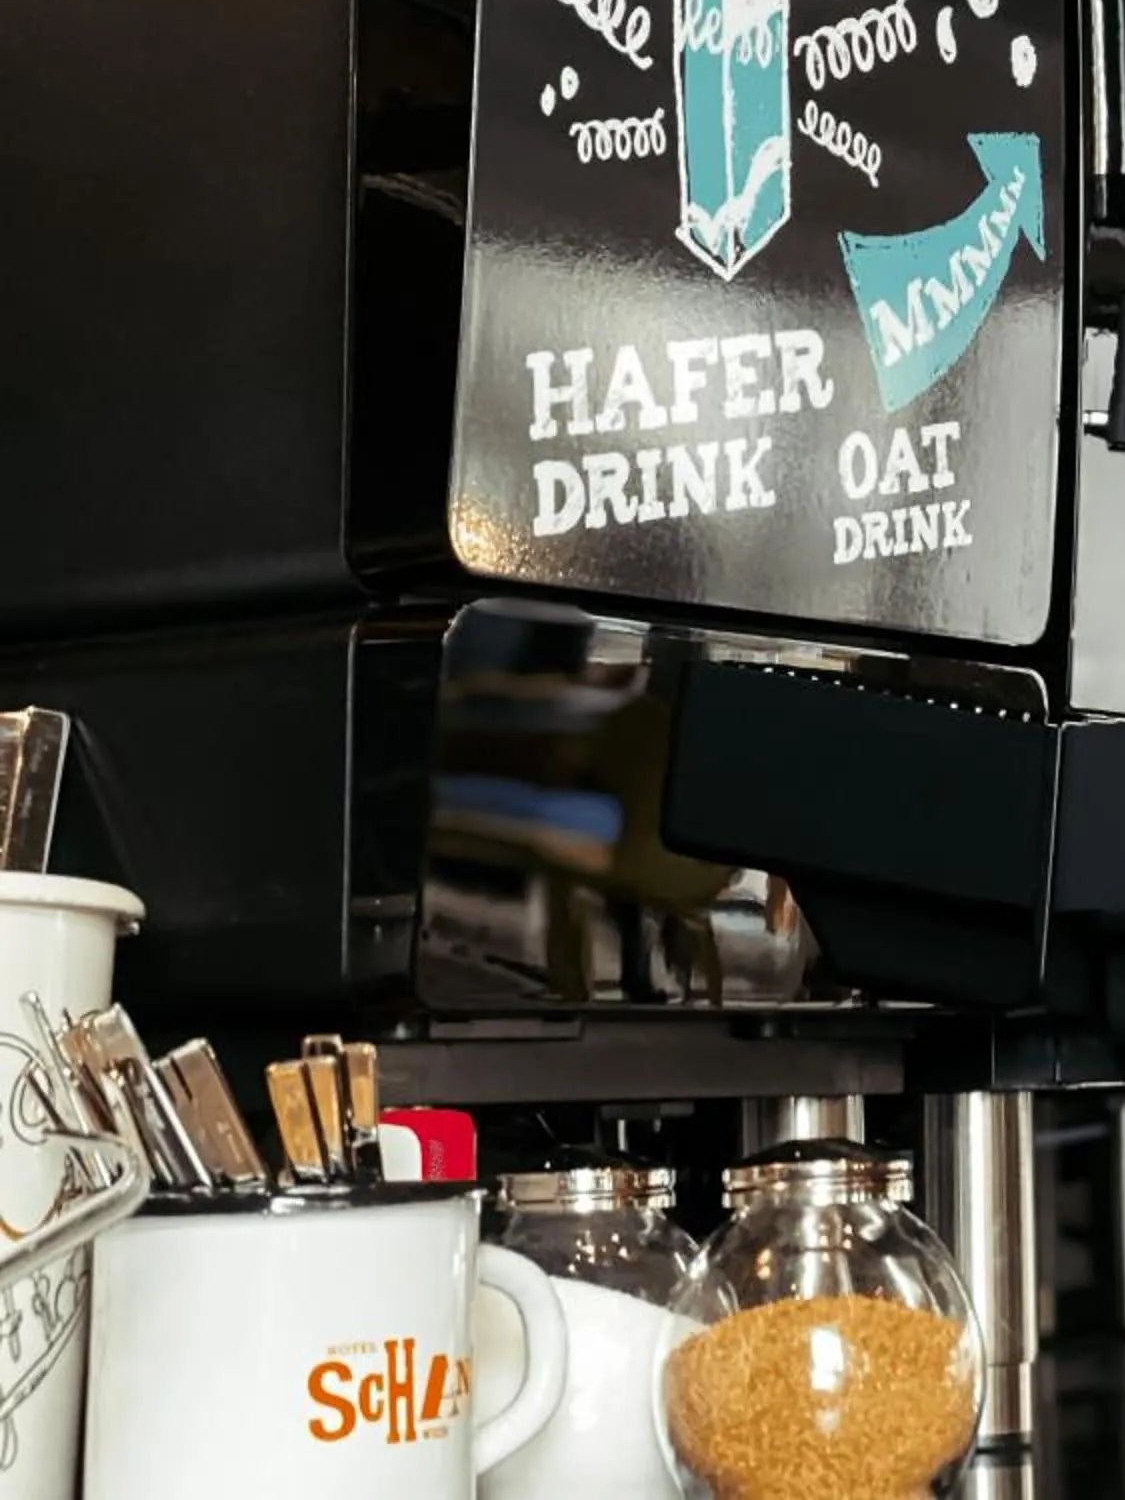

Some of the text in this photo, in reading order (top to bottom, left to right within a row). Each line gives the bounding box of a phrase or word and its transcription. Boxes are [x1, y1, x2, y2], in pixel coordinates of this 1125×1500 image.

[525, 328, 834, 441] HAFER
[532, 435, 776, 537] DRINK
[838, 420, 962, 500] OAT
[832, 499, 974, 565] DRINK
